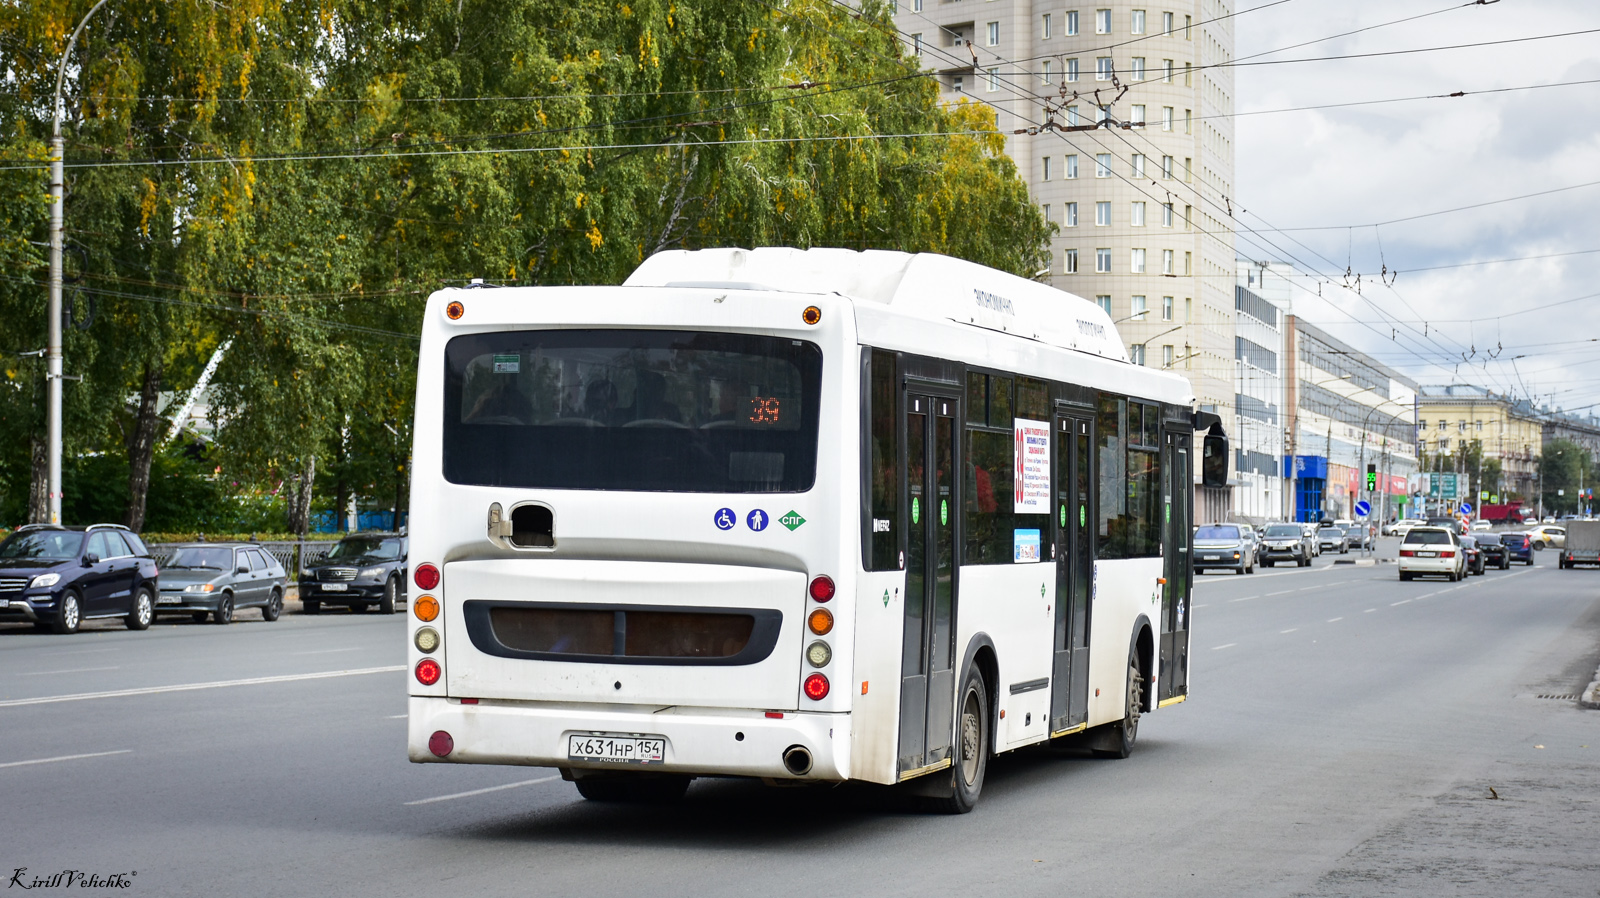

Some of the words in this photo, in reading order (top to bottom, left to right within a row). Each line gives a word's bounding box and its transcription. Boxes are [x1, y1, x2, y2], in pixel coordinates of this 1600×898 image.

[750, 396, 779, 424] 39
[1015, 428, 1024, 503] 39
[781, 516, 802, 525] СПГ
[575, 739, 633, 756] Х631НР
[637, 741, 660, 754] 154
